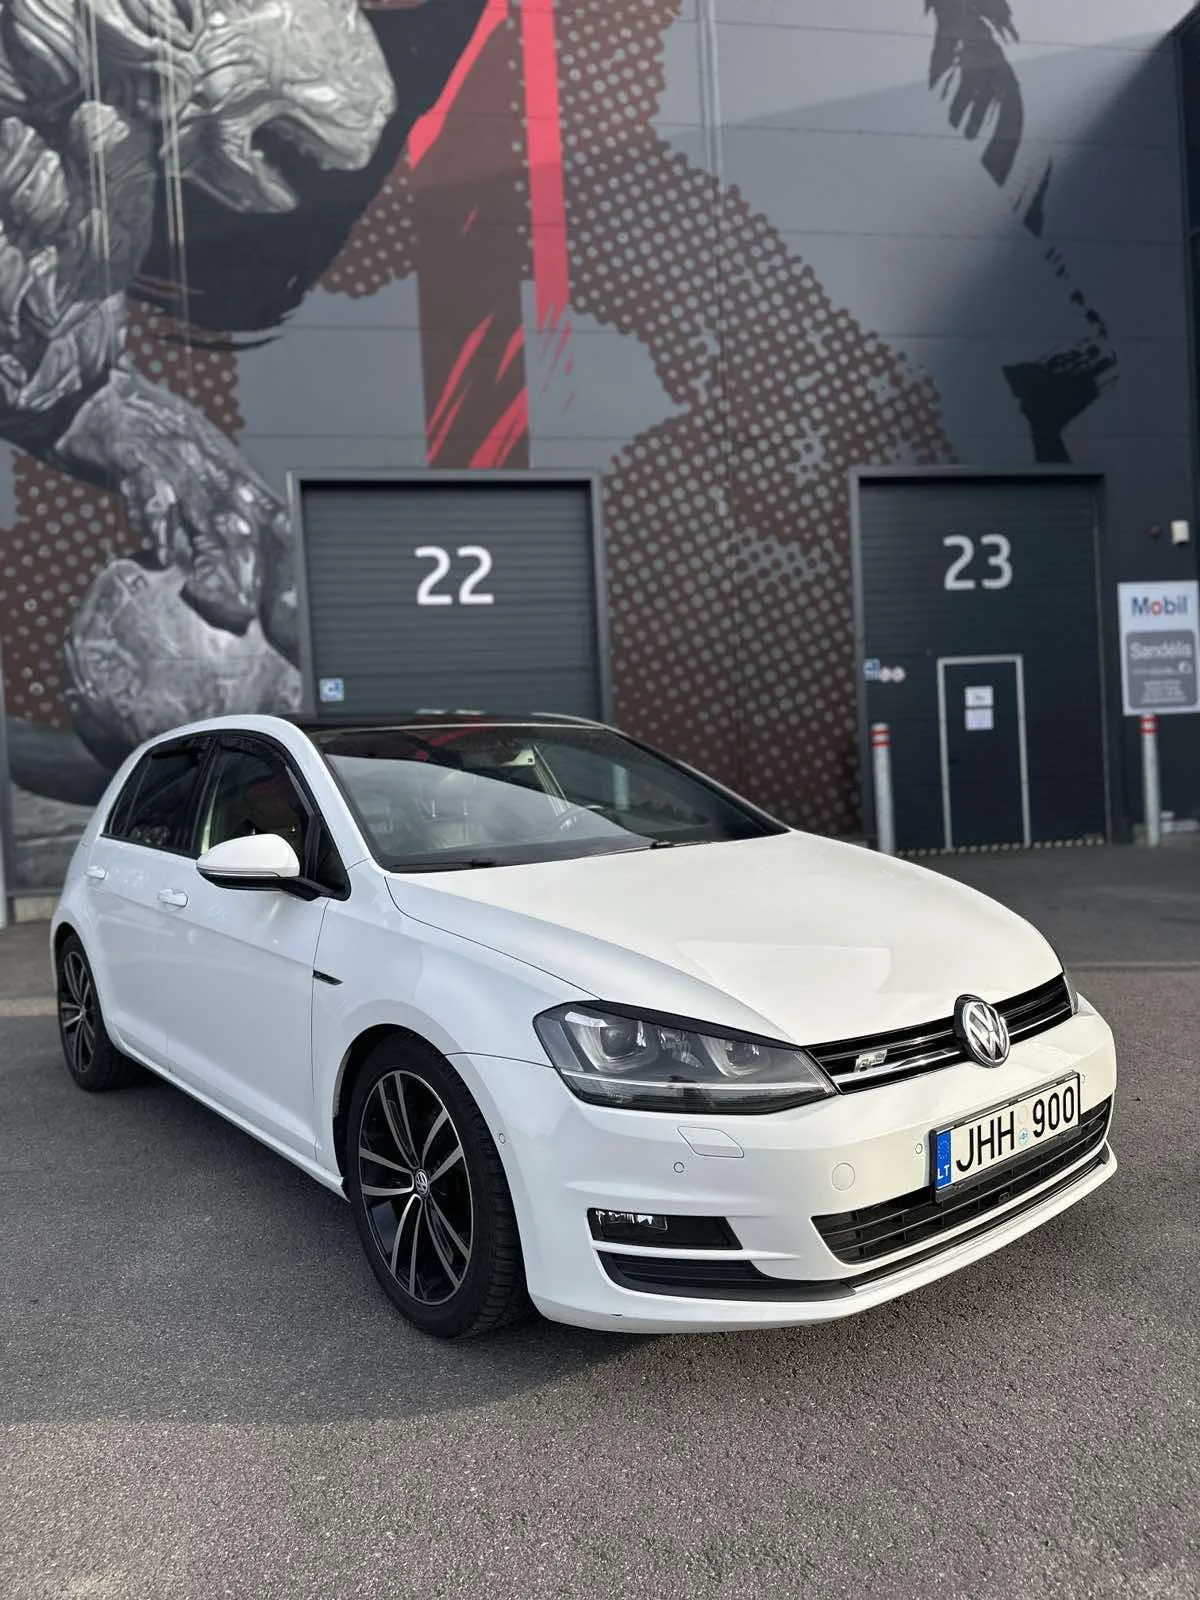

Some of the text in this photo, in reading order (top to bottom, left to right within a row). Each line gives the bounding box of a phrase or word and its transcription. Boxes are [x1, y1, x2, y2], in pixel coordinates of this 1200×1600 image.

[414, 545, 494, 605] 22
[943, 534, 1013, 591] 23
[1131, 595, 1188, 615] Mobil
[956, 1086, 1074, 1172] JHH 900
[937, 1164, 950, 1179] LT
